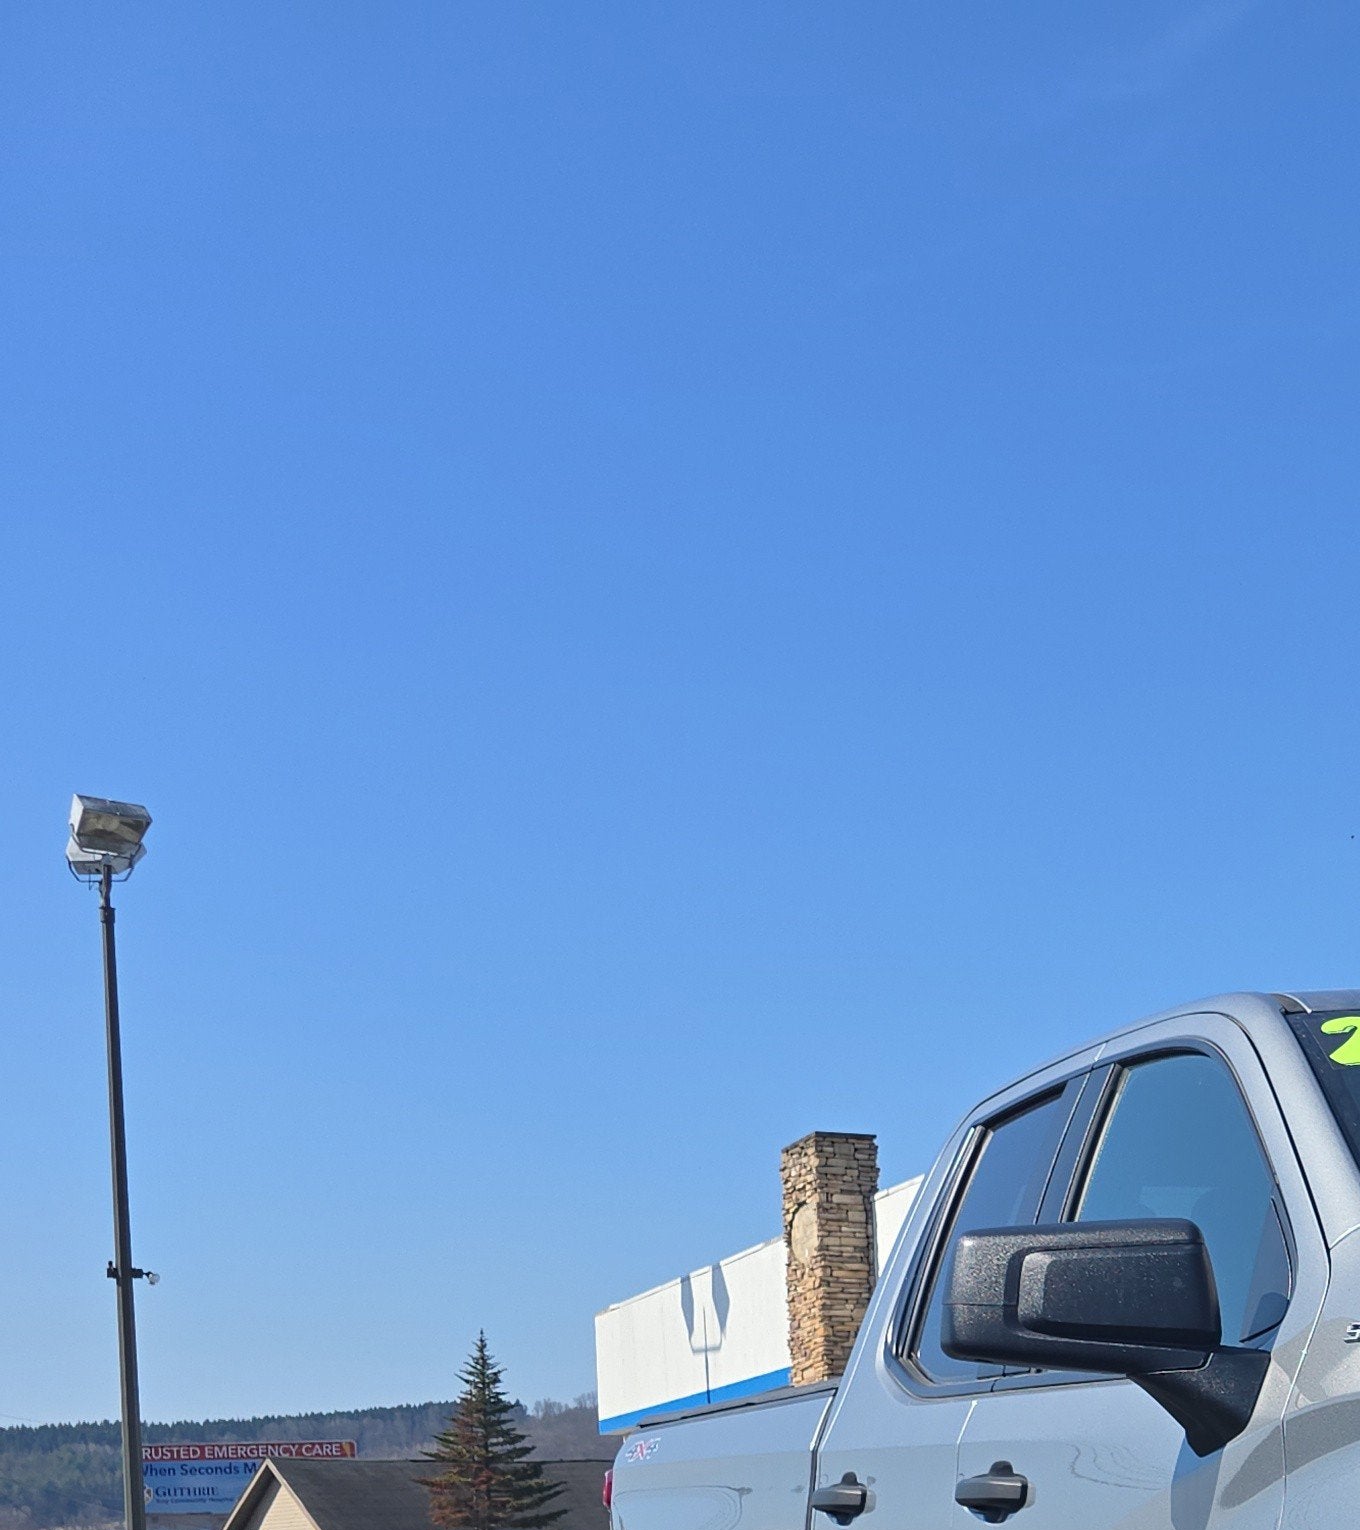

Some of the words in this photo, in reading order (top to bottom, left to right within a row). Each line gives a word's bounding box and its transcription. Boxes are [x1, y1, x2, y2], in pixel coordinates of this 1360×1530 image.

[142, 1446, 201, 1461] RUSTED
[205, 1444, 299, 1459] EMERGENCY
[302, 1442, 341, 1457] CARE
[180, 1462, 240, 1476] Seconds
[243, 1462, 257, 1474] M
[155, 1486, 219, 1498] GUTHRIE
